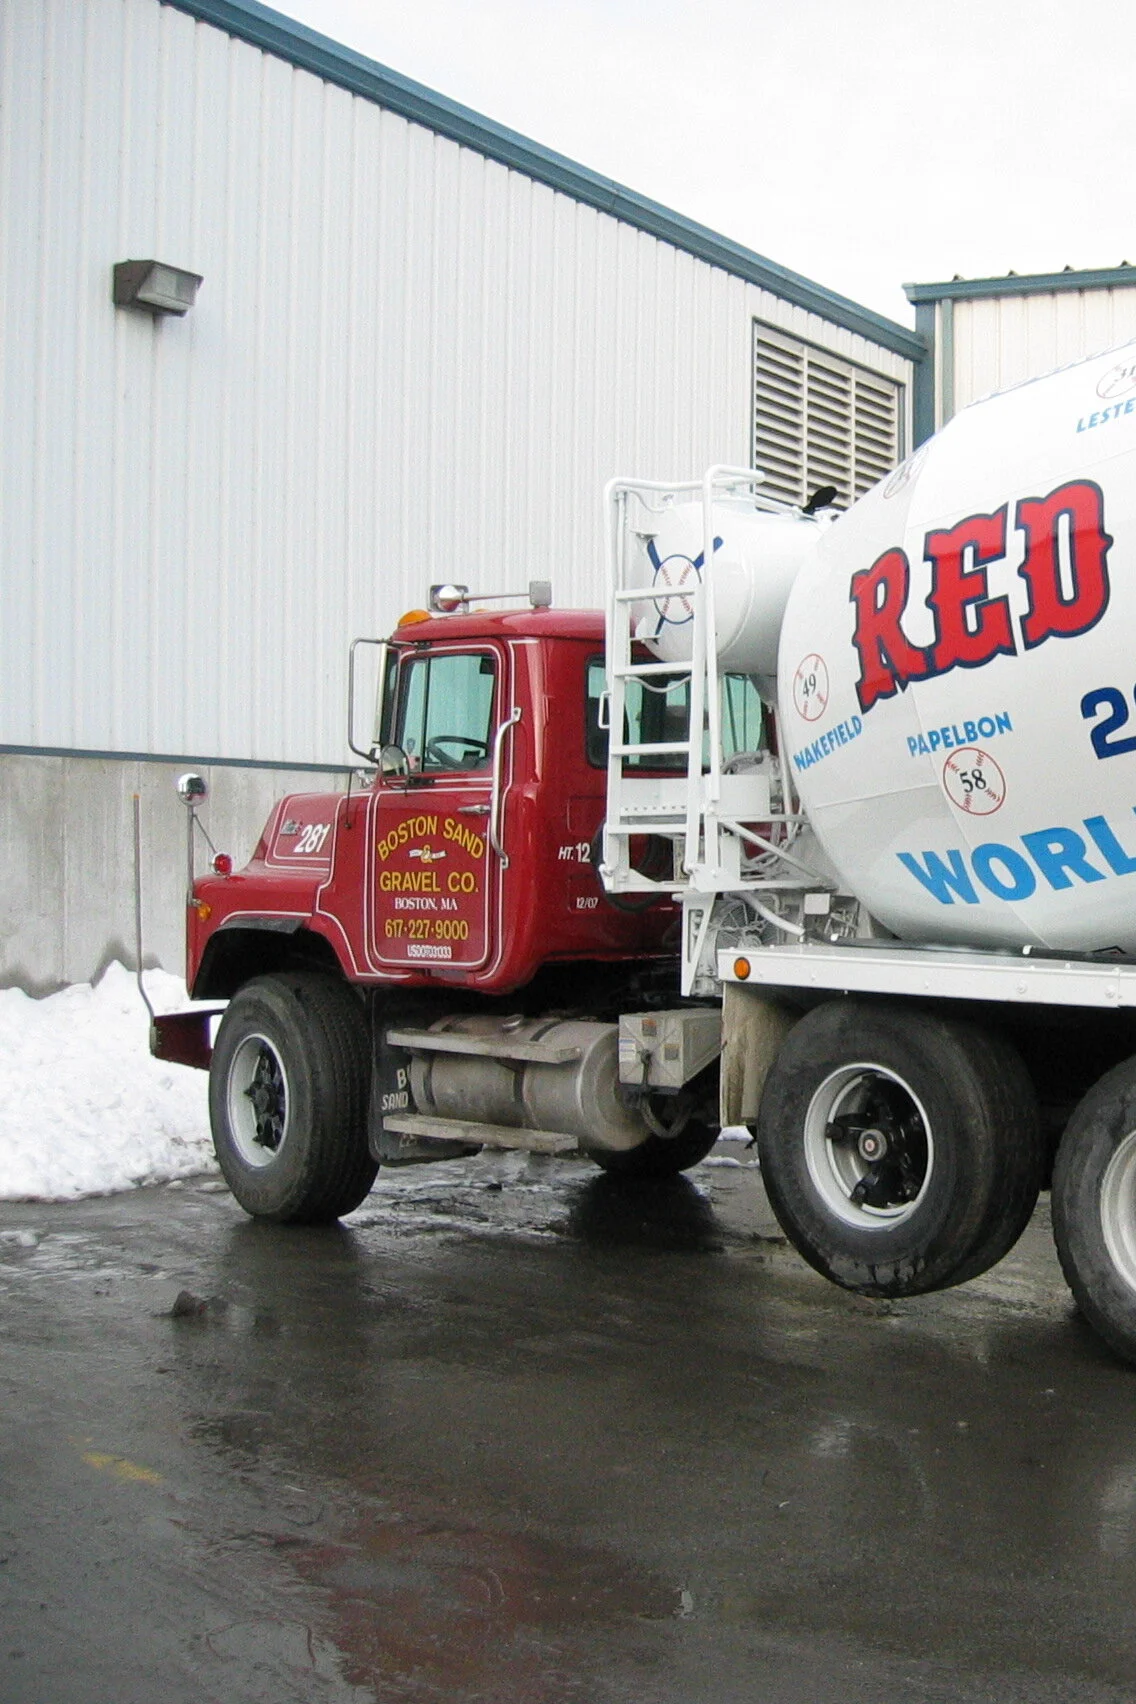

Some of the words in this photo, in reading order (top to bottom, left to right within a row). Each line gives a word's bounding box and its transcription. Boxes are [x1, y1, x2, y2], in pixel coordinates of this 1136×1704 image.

[849, 479, 1114, 714] RED
[802, 673, 817, 698] 49
[793, 714, 864, 773] WAKEFIELD
[906, 711, 1014, 757] PAPELBON
[959, 768, 987, 794] 58
[293, 823, 331, 853] 281
[377, 815, 438, 861] BOSTON
[442, 817, 484, 859] SAND
[558, 846, 574, 860] HT.
[575, 842, 591, 863] 12
[379, 871, 442, 892] GRAVEL
[447, 871, 479, 893] CO.
[394, 897, 438, 911] BOSTON,
[440, 897, 458, 911] MA
[576, 896, 599, 909] 12/07
[396, 1066, 410, 1090] B
[381, 1091, 409, 1111] SAND
